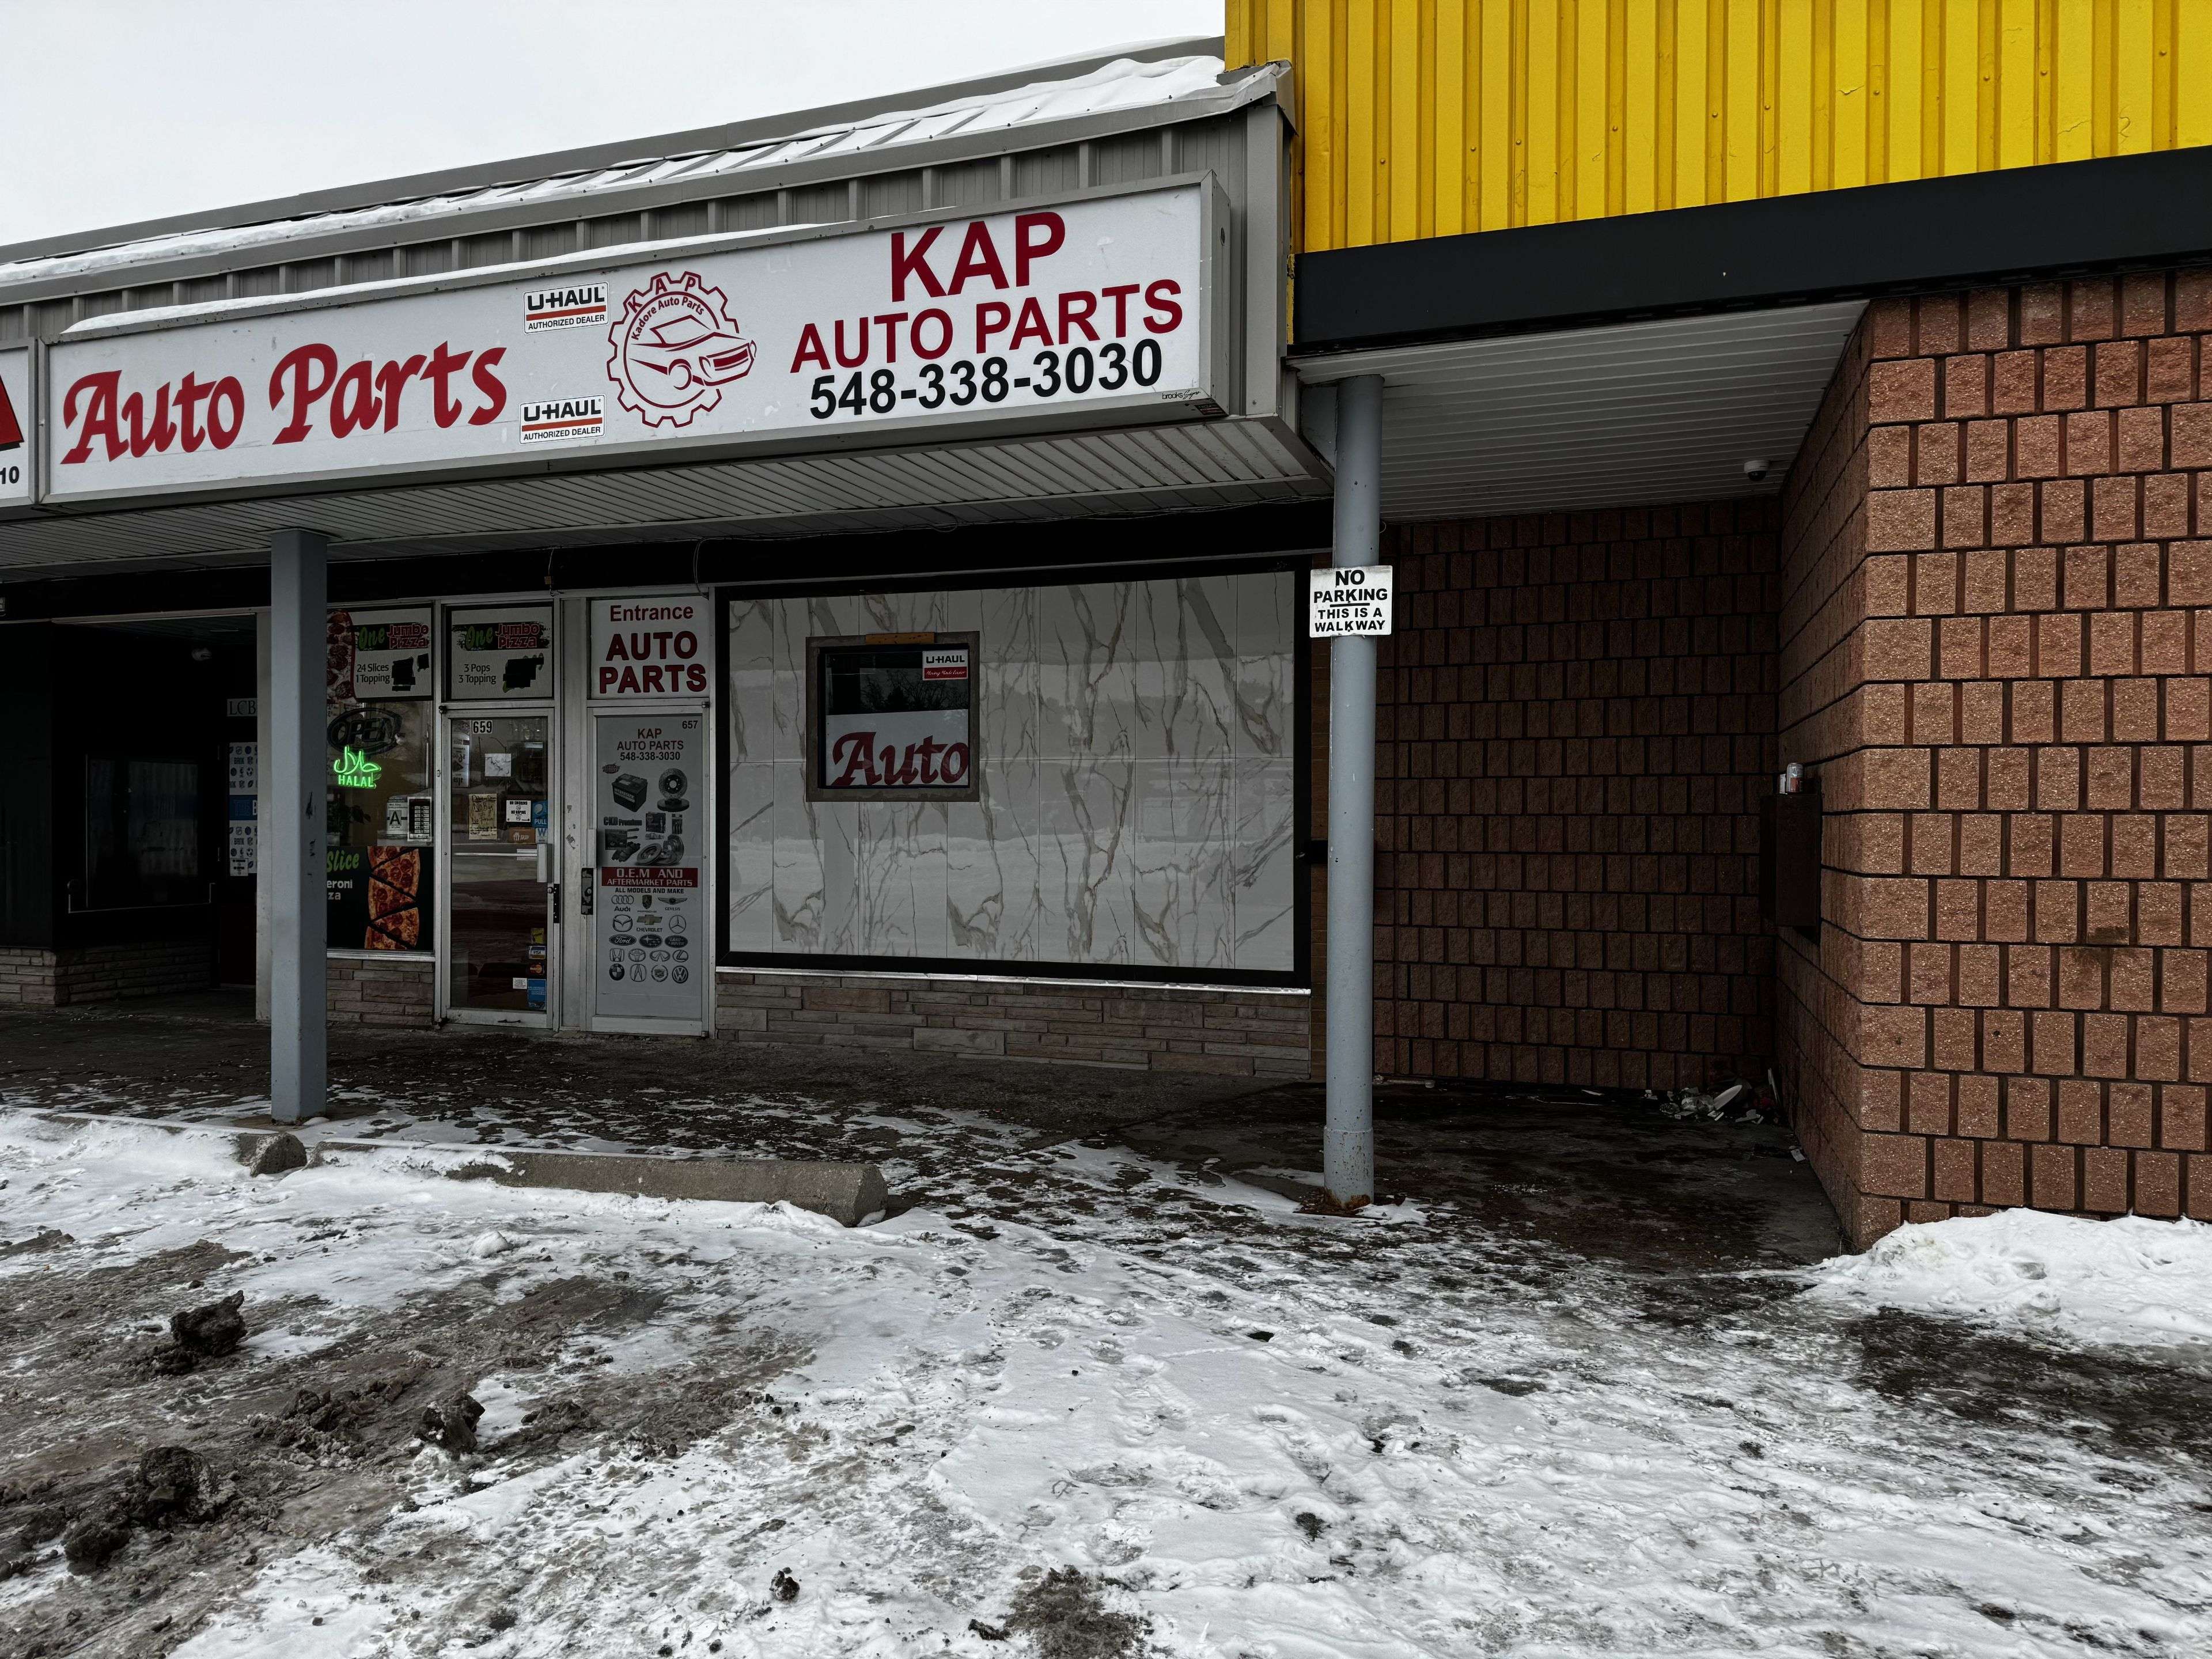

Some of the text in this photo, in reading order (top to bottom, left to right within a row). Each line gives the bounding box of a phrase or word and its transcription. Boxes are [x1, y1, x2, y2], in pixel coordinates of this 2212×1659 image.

[892, 211, 1065, 302] KAP
[528, 315, 605, 331] AUTHORIZED DEALER
[631, 297, 704, 340] Kadore Auto Parts
[790, 279, 1183, 373] AUTO PARTS
[810, 339, 1161, 419] 548-338-3030
[60, 341, 507, 465] Auto Parts
[1162, 392, 1183, 400] brooks
[524, 427, 600, 441] AUTHORIZED DEALER
[1335, 570, 1365, 586] NO
[1313, 588, 1388, 603] PARKING
[610, 605, 694, 622] Entrance
[1318, 607, 1382, 619] THIS IS A
[1315, 620, 1385, 632] WALKWAY
[359, 624, 429, 650] One Jumbo
[465, 623, 540, 648] One Jumbo
[498, 635, 537, 649] Pizza
[388, 637, 429, 649] Pizza
[606, 631, 698, 661] AUTO
[357, 663, 389, 672] 24 Slices
[464, 663, 490, 674] 3 Pops
[361, 673, 390, 684] Topping
[459, 673, 497, 685] 3 Topping
[599, 664, 707, 694] PARTS
[472, 721, 493, 733] 659
[681, 720, 698, 729] 657
[637, 728, 662, 739] KAP
[617, 740, 684, 751] AUTO PARTS
[620, 751, 681, 761] 548-338-3030
[831, 732, 969, 786] Auto
[338, 774, 376, 788] HALAL
[327, 850, 360, 873] Slice
[616, 868, 683, 878] O.E.M AND
